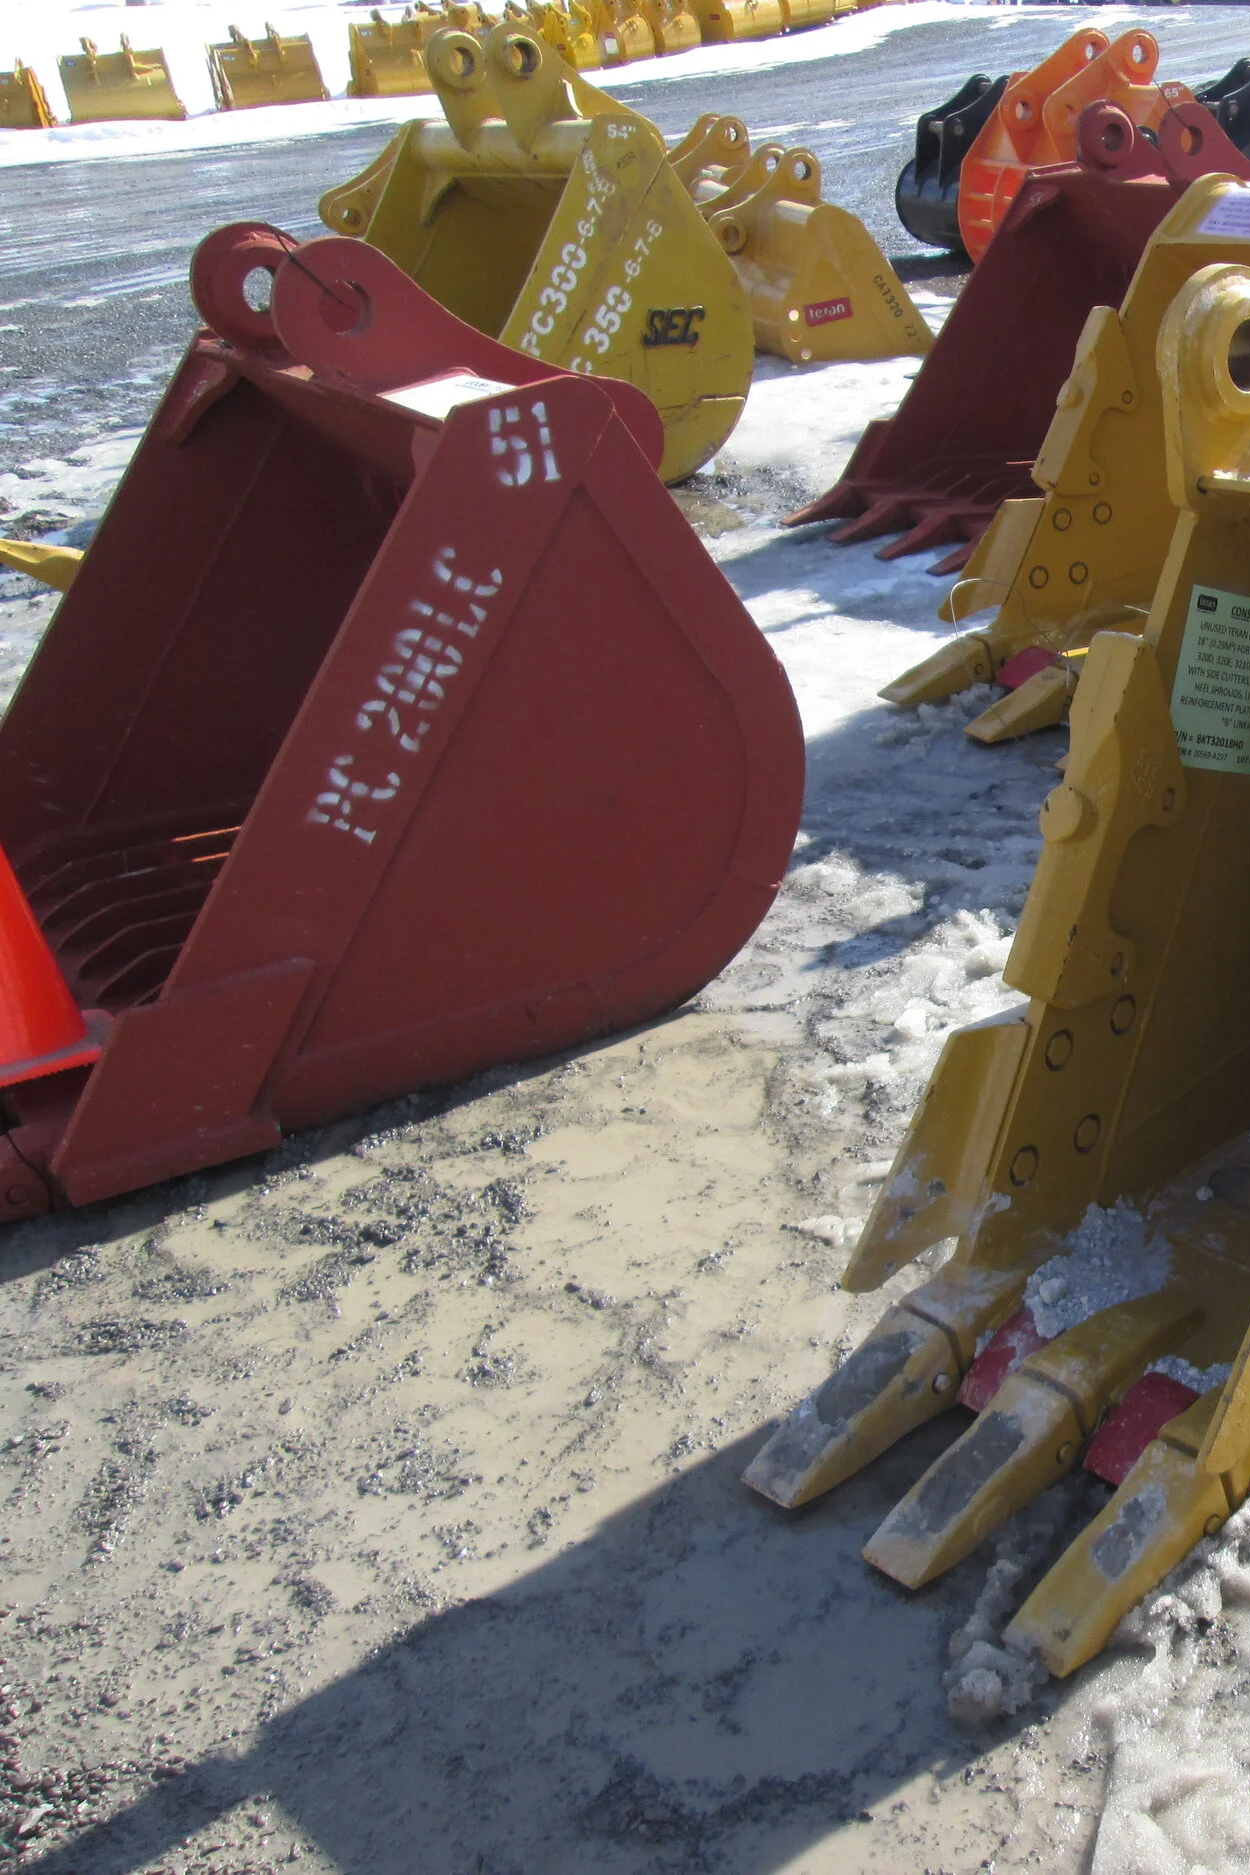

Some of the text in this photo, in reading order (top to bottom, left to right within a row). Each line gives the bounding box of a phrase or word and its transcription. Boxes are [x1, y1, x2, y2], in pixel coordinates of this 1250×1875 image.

[1164, 86, 1184, 97] 65"
[607, 123, 637, 139] 54"
[873, 275, 904, 318] CAT320
[809, 303, 846, 320] teran
[641, 307, 705, 347] SEC
[488, 400, 561, 487] 51
[1200, 621, 1227, 635] UNUSED
[1228, 627, 1248, 639] TERAN
[1237, 644, 1250, 655] FOR
[1188, 665, 1206, 676] WITH
[1206, 669, 1220, 680] SIDE
[1221, 672, 1250, 687] CUTTERS,
[1194, 682, 1209, 693] HEEL
[1210, 685, 1243, 700] SHROUDS,
[1180, 695, 1235, 712] REINFORCEMENT
[1196, 734, 1244, 750] BKT32018HD
[1237, 755, 1249, 765] LOT
[306, 754, 401, 846] PC
